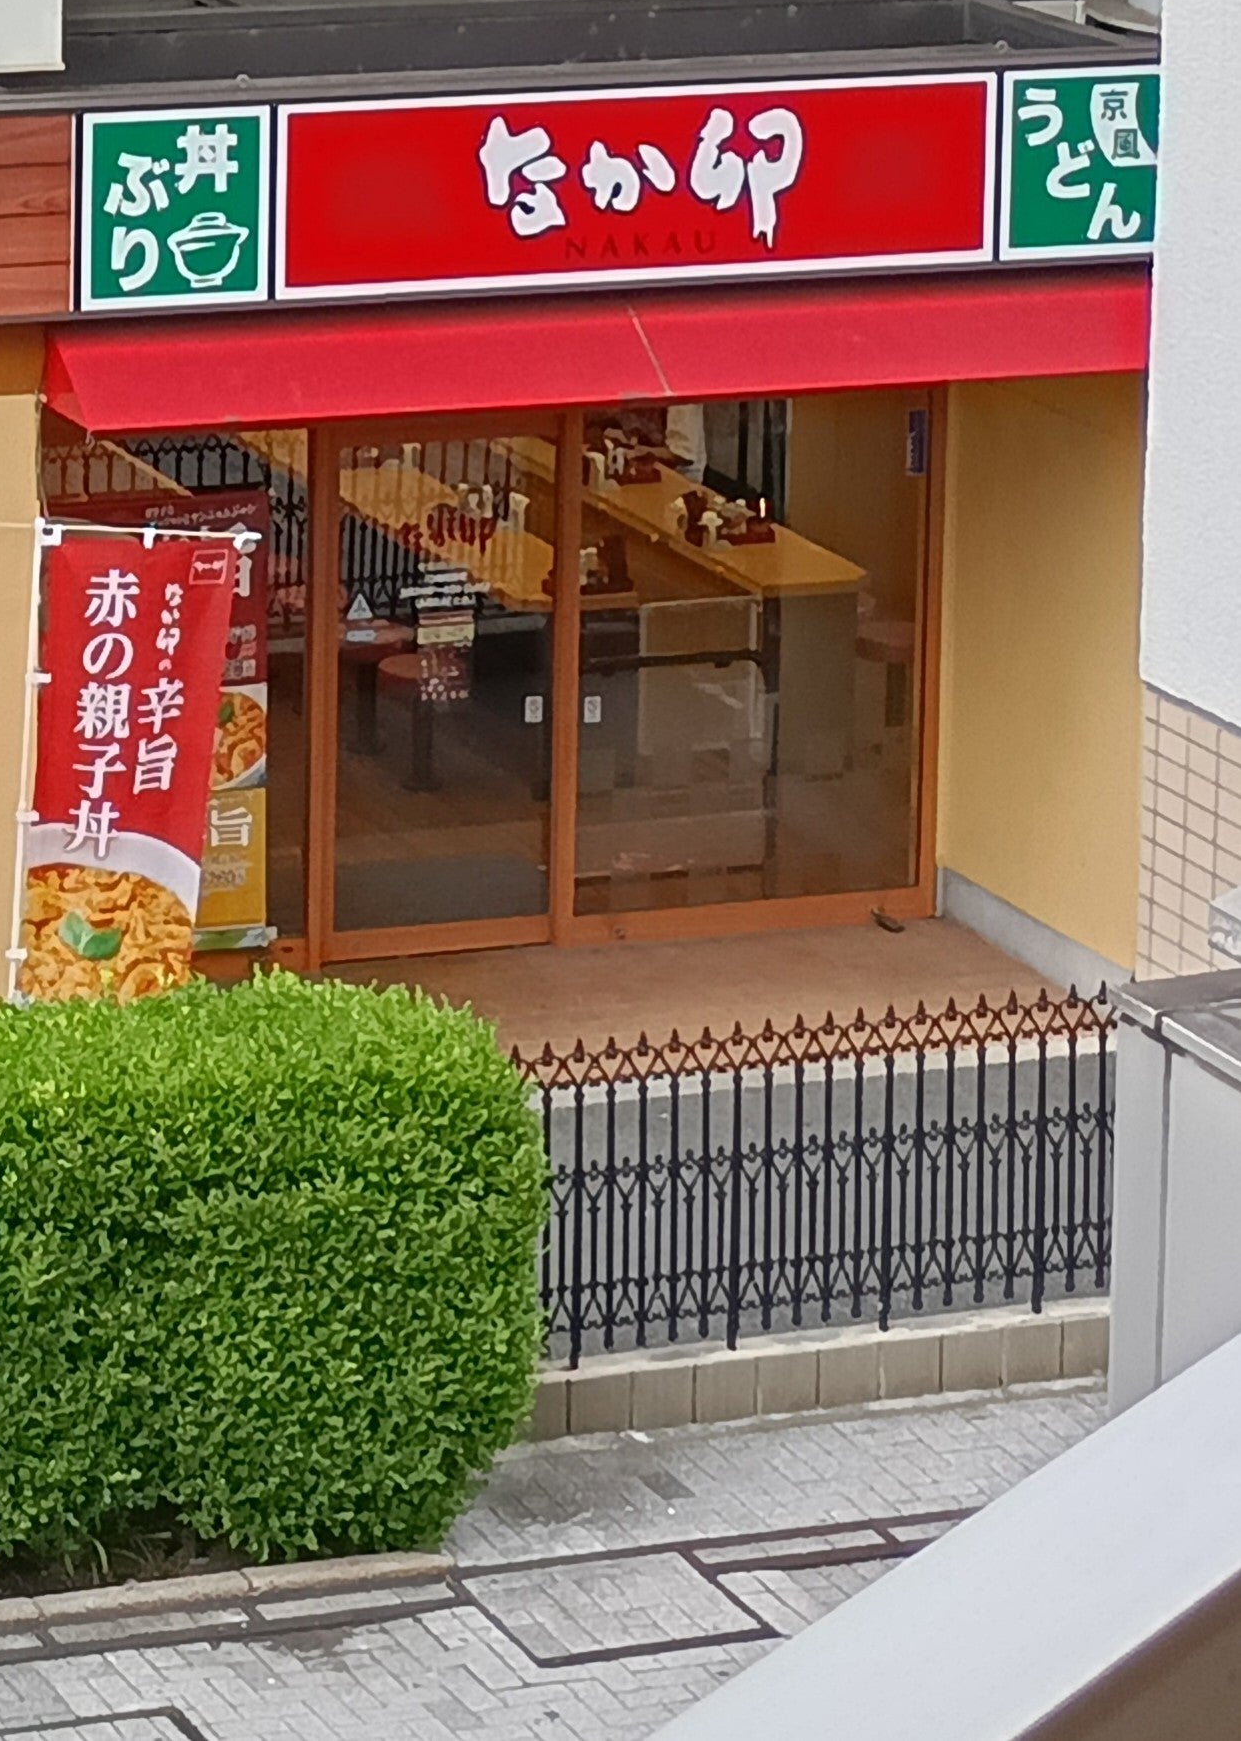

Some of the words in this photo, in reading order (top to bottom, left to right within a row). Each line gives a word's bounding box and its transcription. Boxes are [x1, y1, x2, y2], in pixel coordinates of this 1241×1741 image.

[479, 107, 804, 248] なか卯
[1017, 87, 1141, 240] うどん
[1099, 89, 1141, 160] 京風
[564, 229, 716, 259] NAKAU
[63, 569, 140, 858] 赤の親子丼
